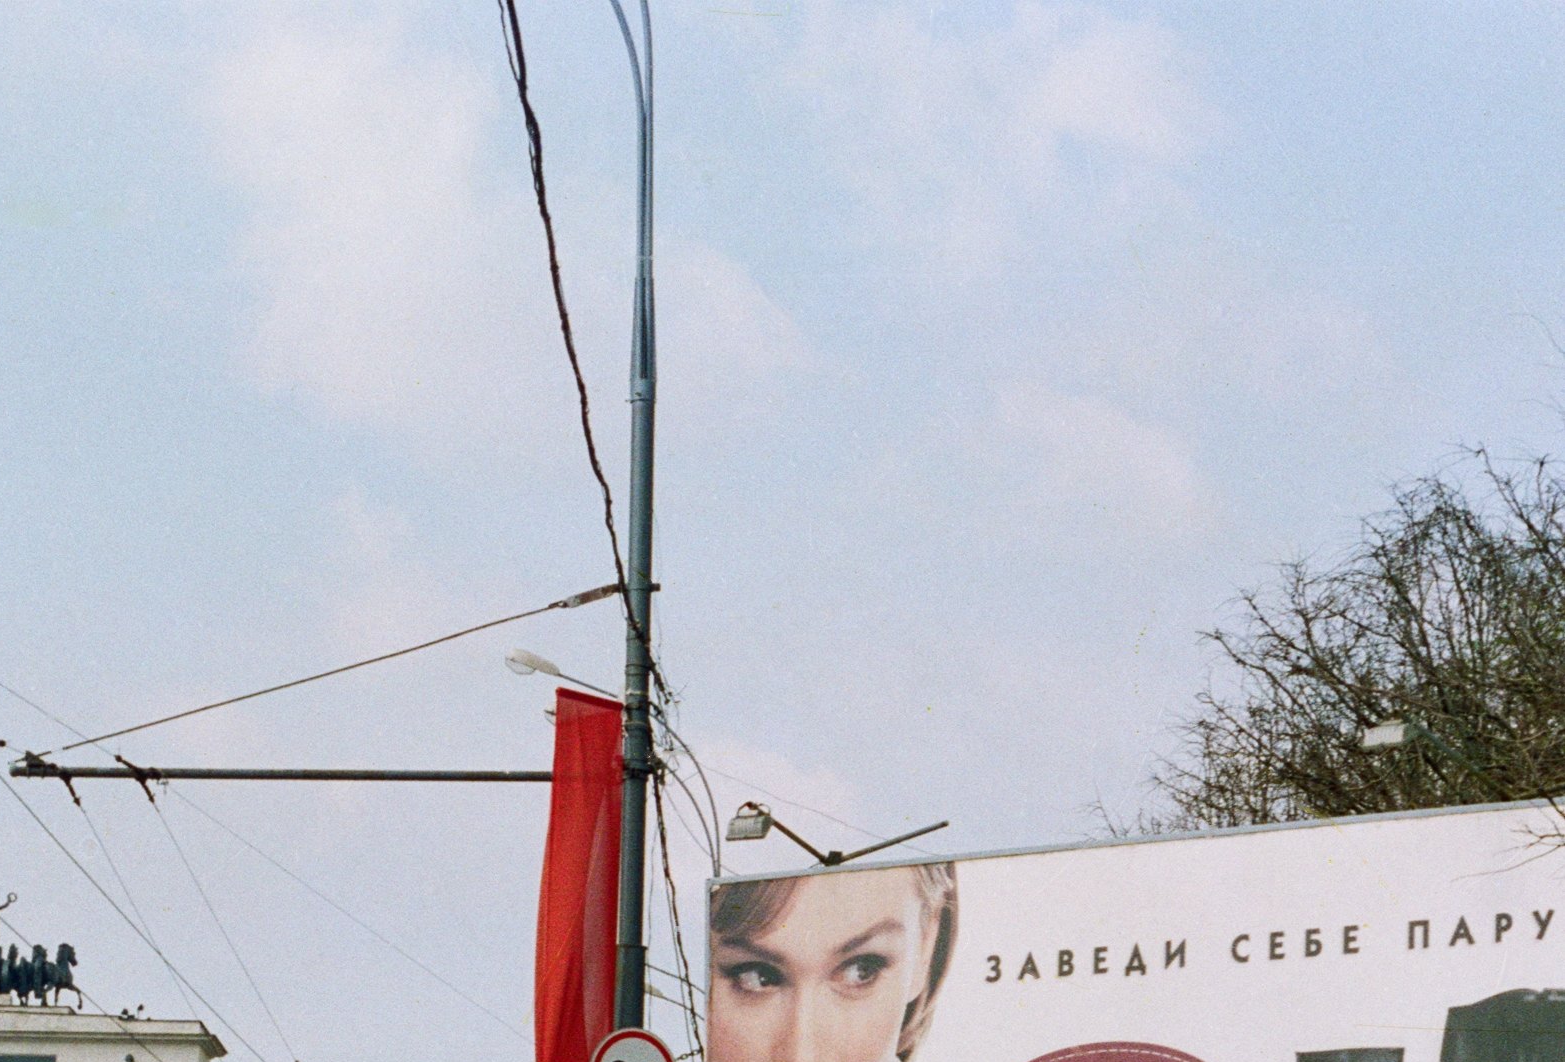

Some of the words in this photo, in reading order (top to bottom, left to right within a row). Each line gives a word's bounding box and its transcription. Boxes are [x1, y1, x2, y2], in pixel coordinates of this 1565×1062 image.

[985, 938, 1186, 983] ЗАВЕДИ
[1231, 925, 1360, 963] СЕБЕ
[1408, 909, 1555, 950] ПАРУ
